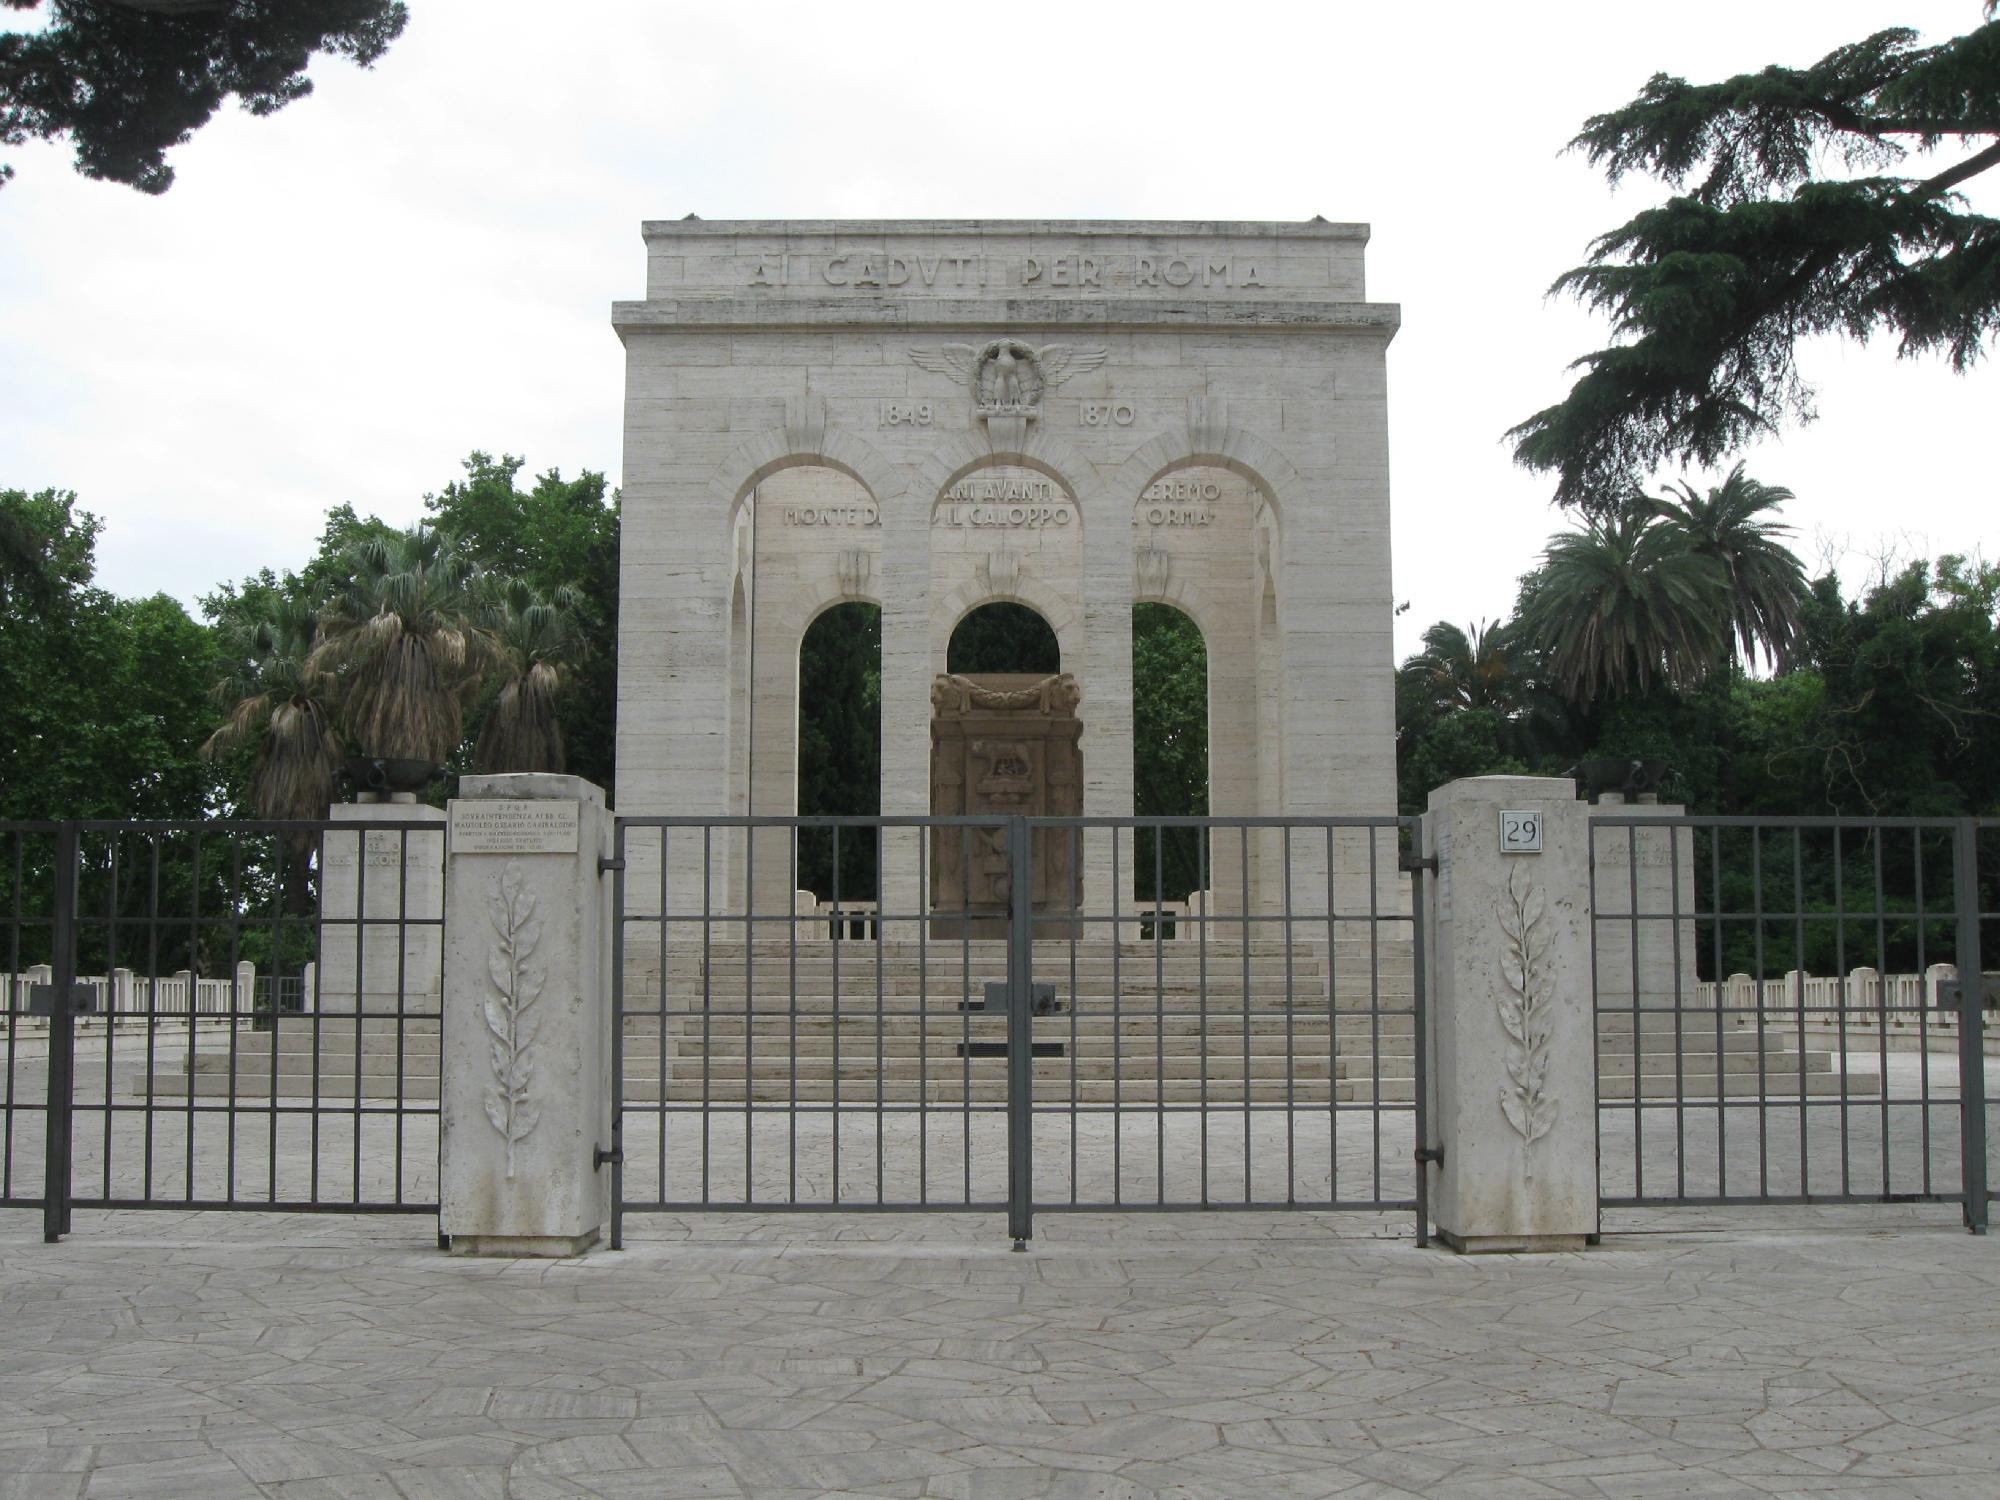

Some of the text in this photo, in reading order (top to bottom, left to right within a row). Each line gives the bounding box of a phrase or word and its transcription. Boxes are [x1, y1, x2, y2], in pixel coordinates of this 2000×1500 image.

[748, 253, 1266, 288] AI CADVTI PER ROMA
[880, 404, 1136, 427] 1849 1870
[983, 480, 1054, 501] AVANTI
[784, 507, 856, 527] MONTE
[947, 506, 963, 526] IL
[1506, 820, 1536, 843] 29
